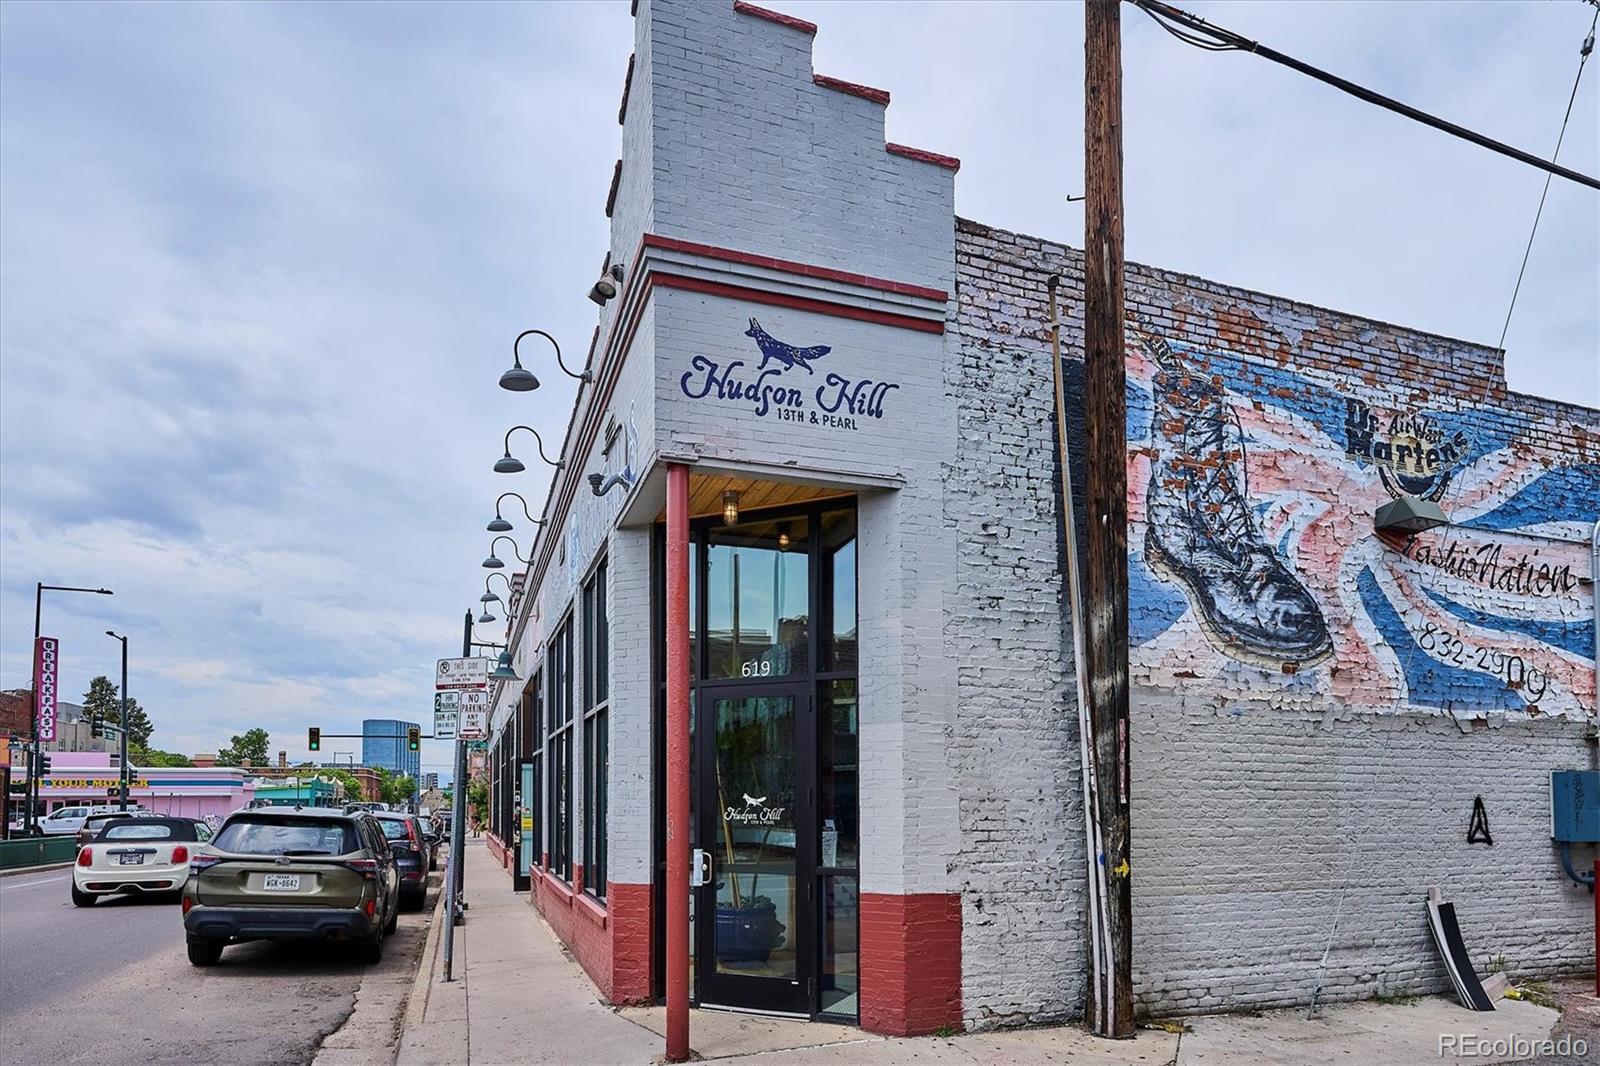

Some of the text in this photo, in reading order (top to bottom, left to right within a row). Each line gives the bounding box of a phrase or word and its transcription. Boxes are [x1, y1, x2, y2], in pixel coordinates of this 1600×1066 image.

[680, 355, 900, 419] Hudson Hill
[778, 408, 858, 430] 13TH & PEARL
[741, 661, 771, 677] 619
[1419, 621, 1546, 704] 832-2909
[43, 640, 54, 739] BREAKFAST
[435, 696, 441, 709] 2
[468, 694, 479, 703] NO
[461, 704, 486, 713] PARKING
[51, 779, 87, 788] YOUR
[92, 779, 149, 788] MOTR
[723, 806, 785, 824] Hudson Hill
